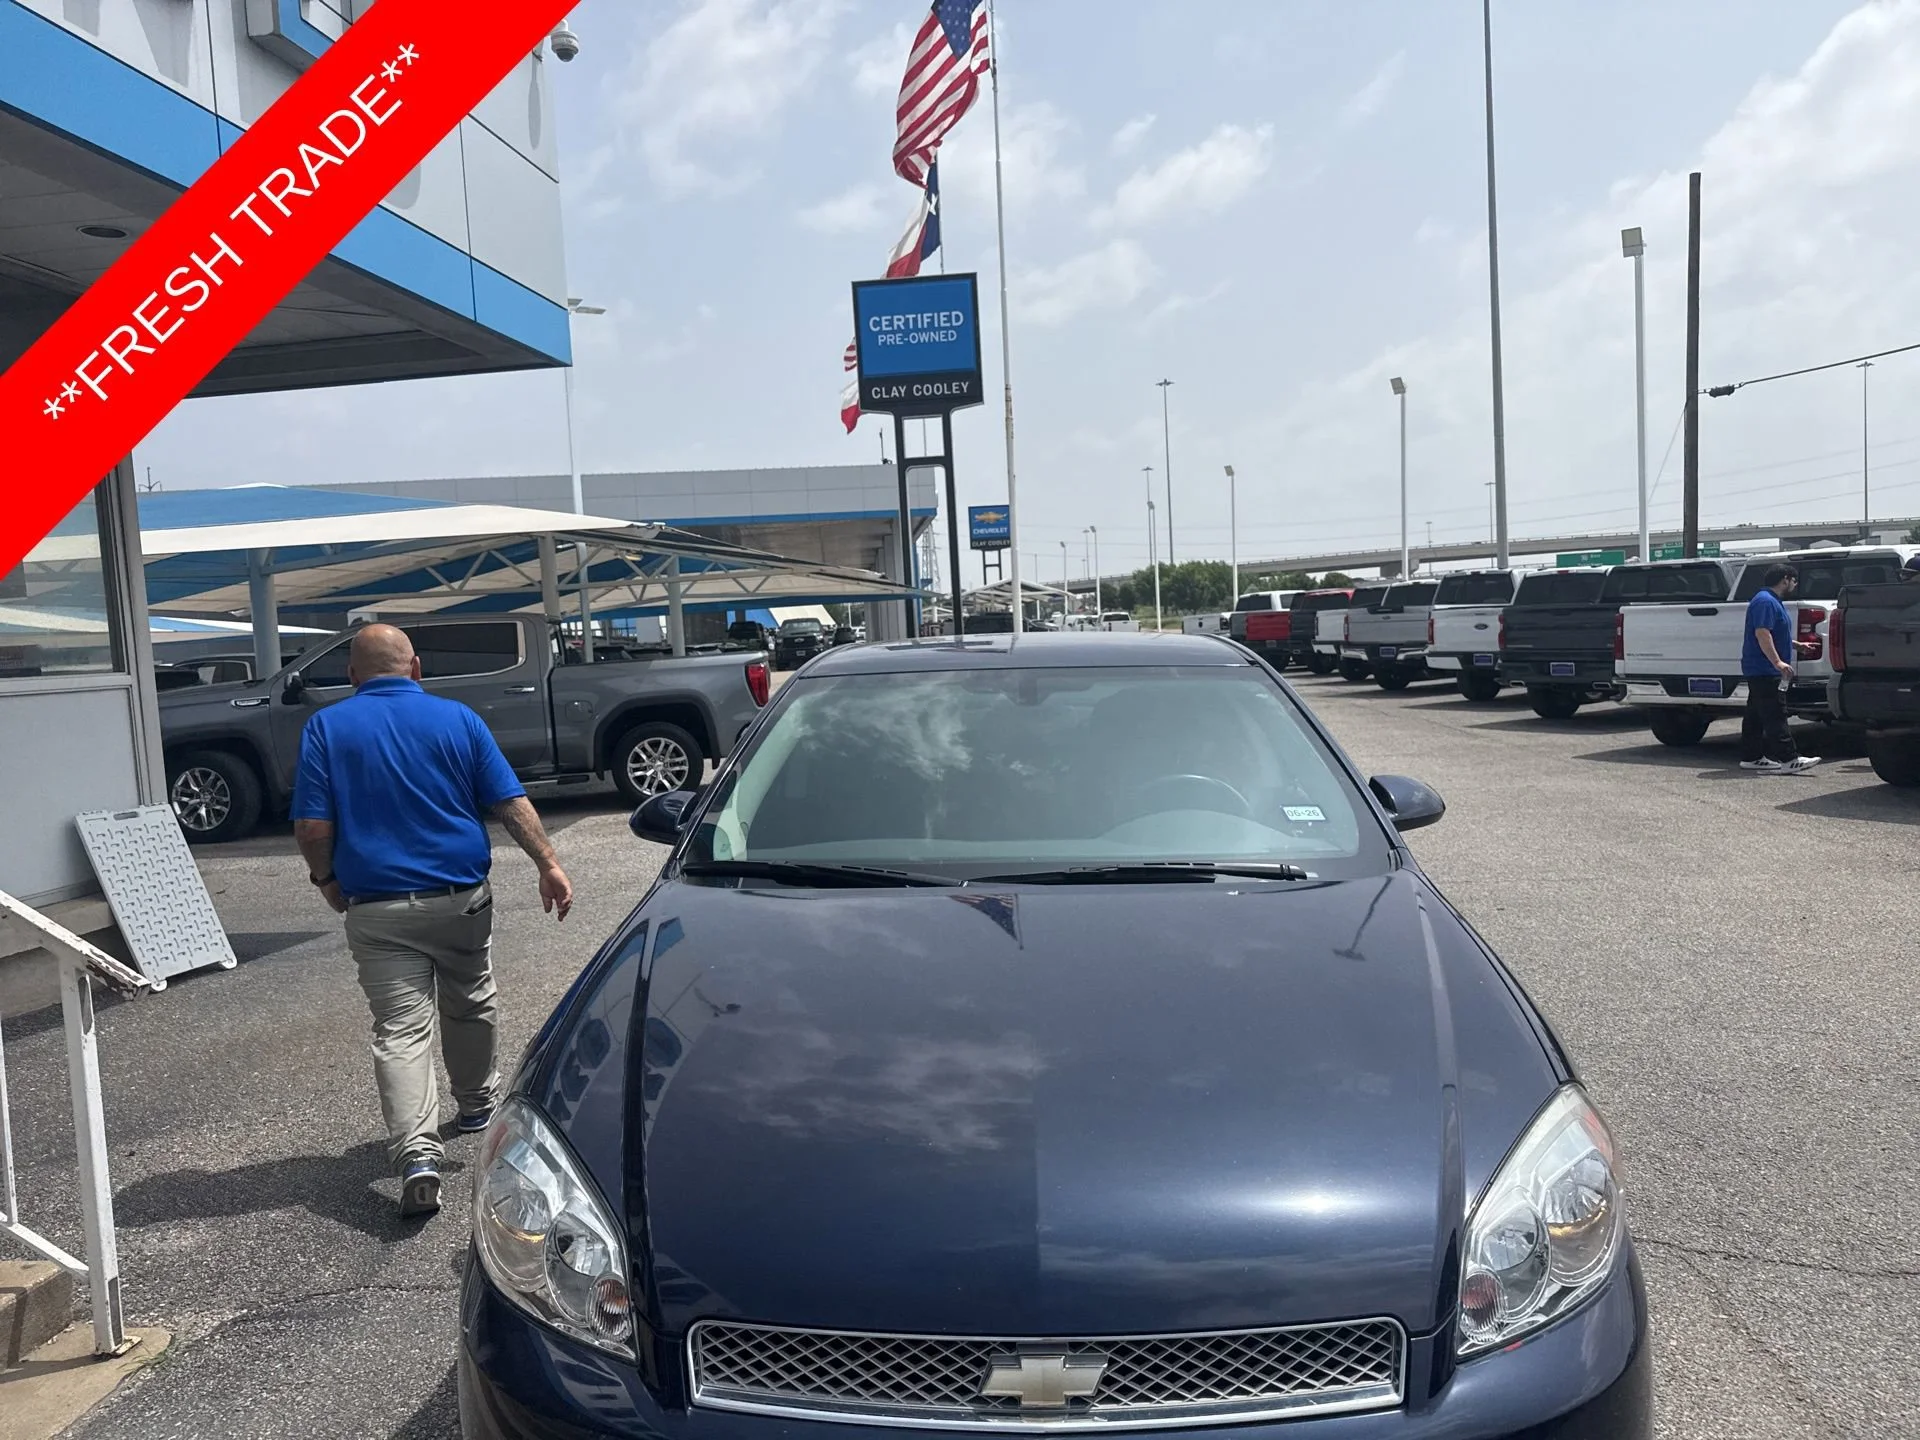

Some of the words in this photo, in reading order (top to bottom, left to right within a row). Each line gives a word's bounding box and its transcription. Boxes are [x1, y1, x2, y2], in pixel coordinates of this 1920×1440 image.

[869, 311, 964, 331] CERTIFIED
[878, 330, 957, 346] PRE-OWNED
[871, 385, 907, 399] CLAY
[912, 381, 970, 397] COOLEY
[1286, 809, 1320, 817] 06-26
